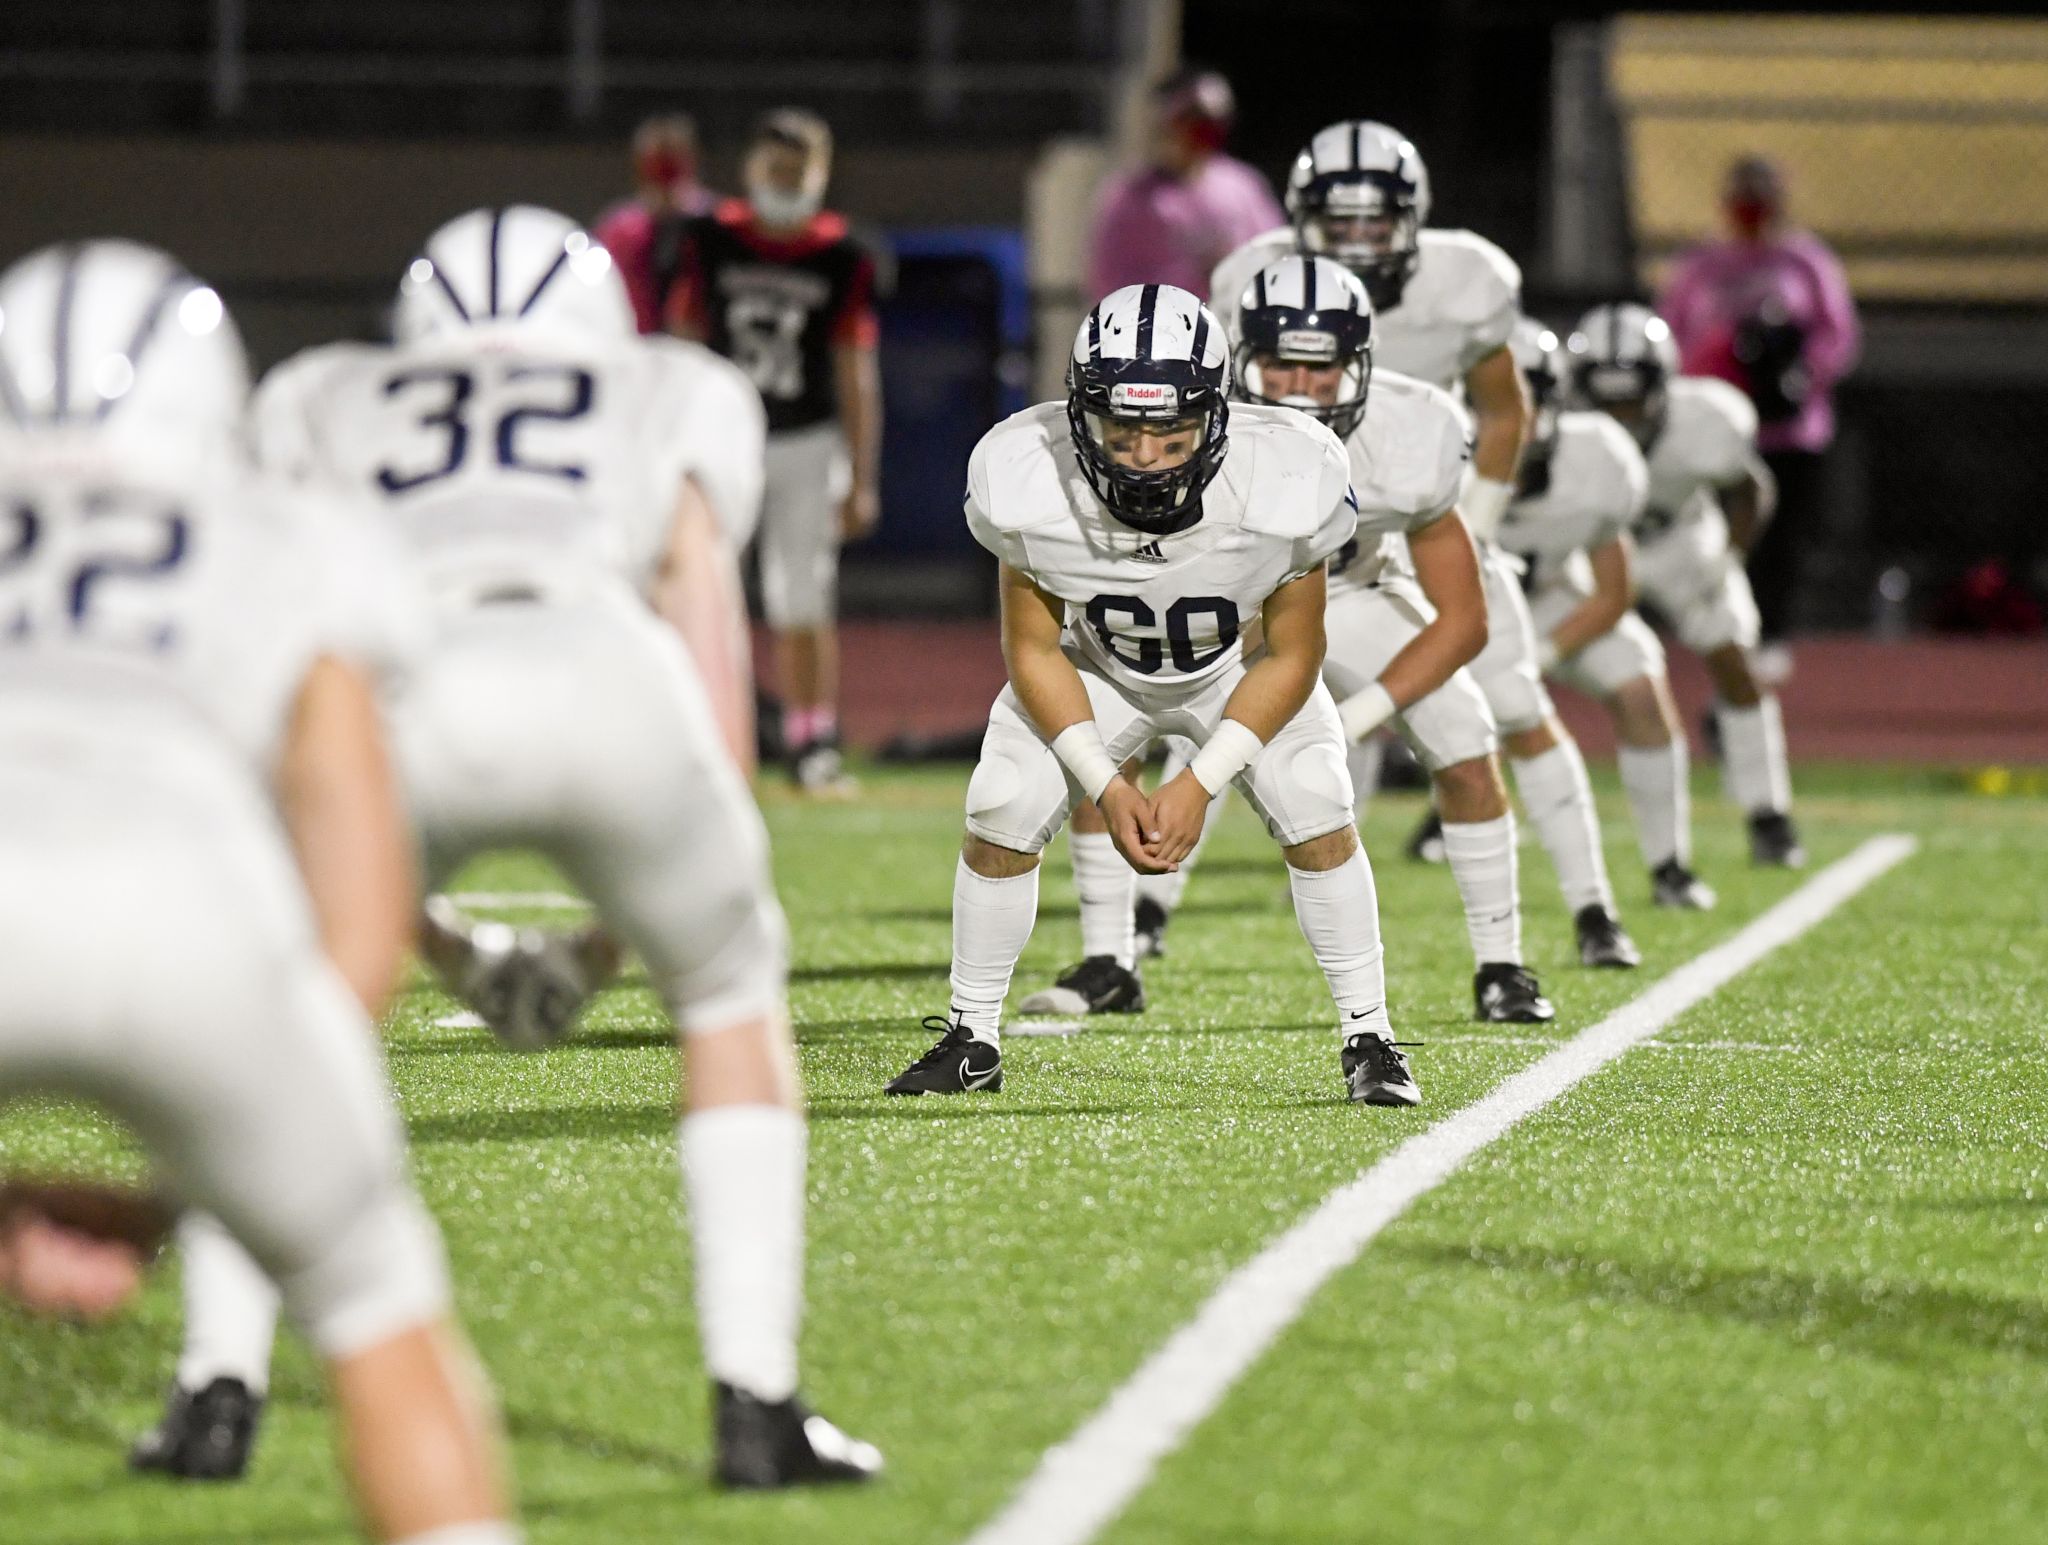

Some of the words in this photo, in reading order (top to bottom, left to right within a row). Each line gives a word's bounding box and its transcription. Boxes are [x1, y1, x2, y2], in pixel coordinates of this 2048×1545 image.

[1127, 387, 1162, 398] Riddell
[378, 364, 593, 491] 32
[1130, 553, 1168, 564] adidas
[1086, 594, 1240, 675] 60
